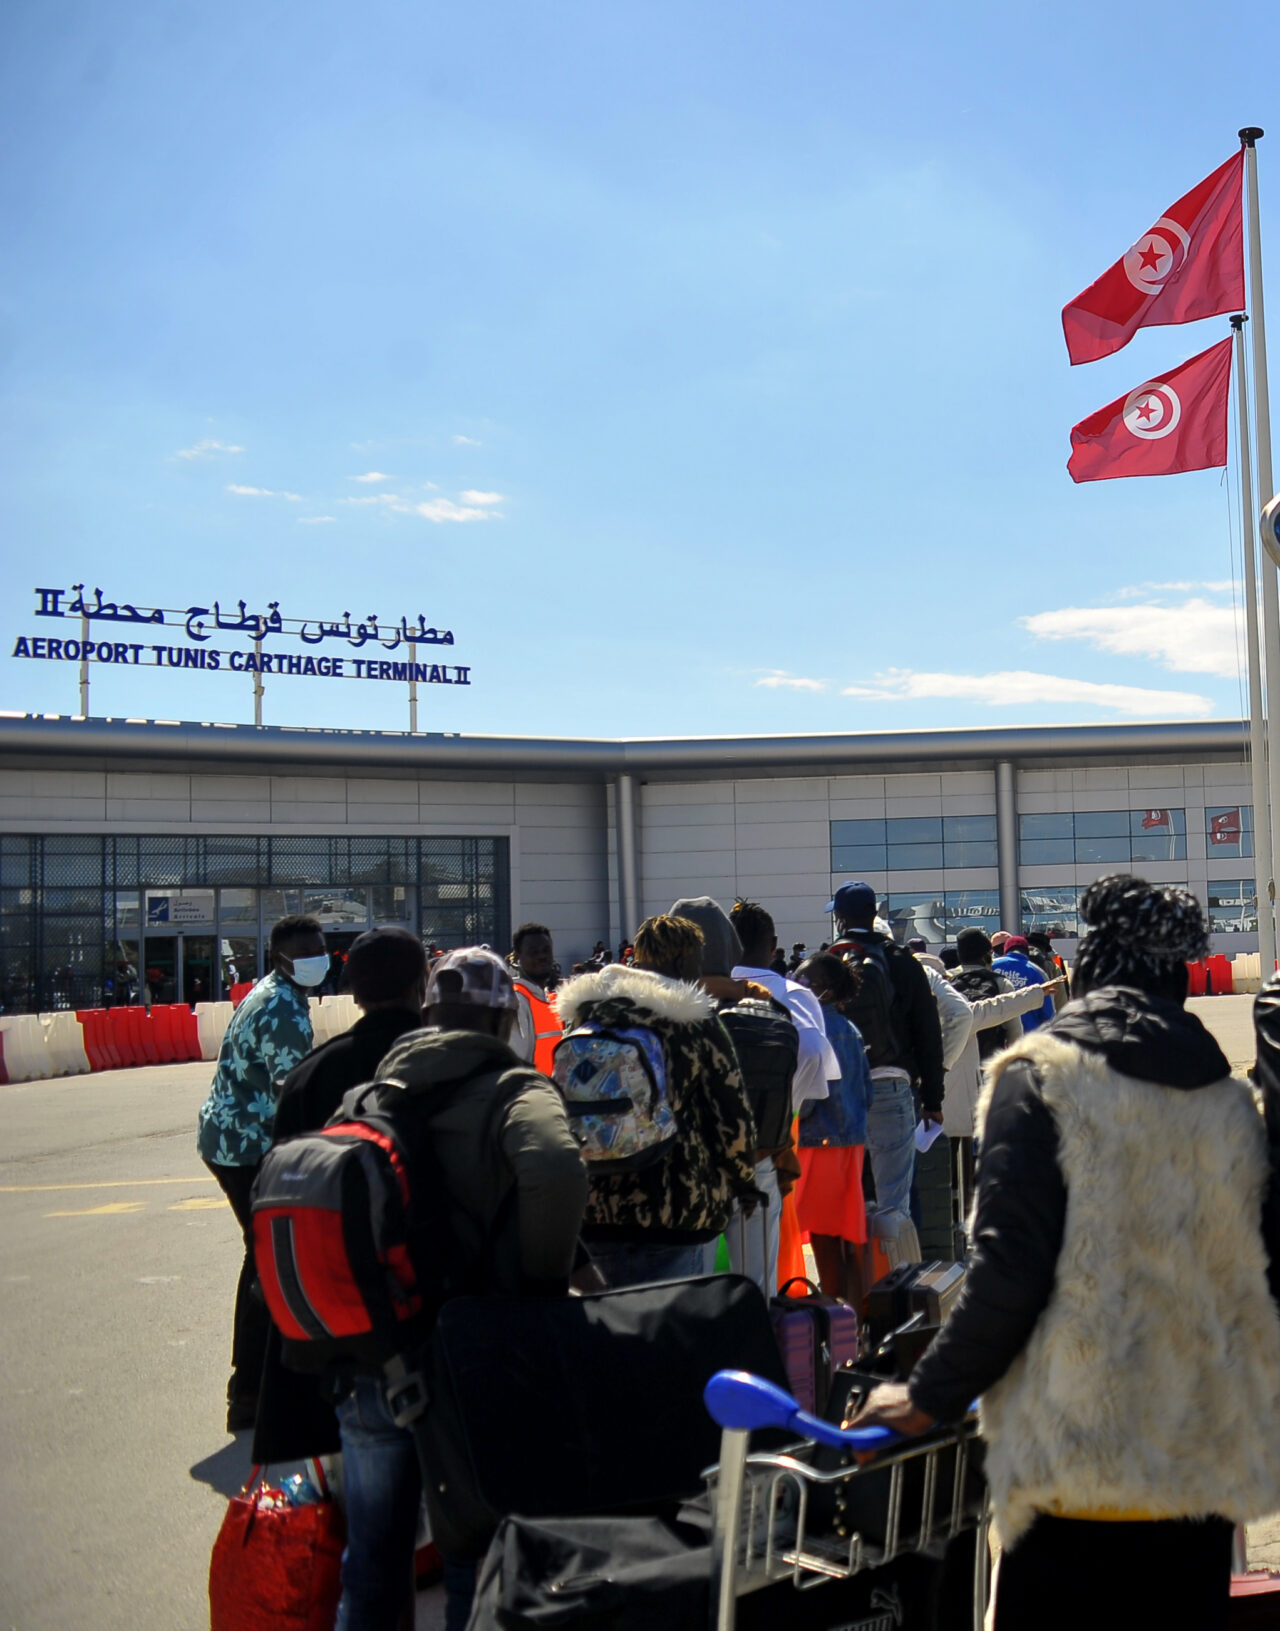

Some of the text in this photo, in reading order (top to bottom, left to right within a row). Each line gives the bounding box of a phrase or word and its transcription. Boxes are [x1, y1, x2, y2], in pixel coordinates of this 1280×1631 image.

[34, 583, 454, 650] مطار تونس قرطاج محطة II
[12, 636, 145, 665] AEROPORT
[152, 645, 221, 670] TUNIS
[229, 651, 344, 677] CARTHAGE
